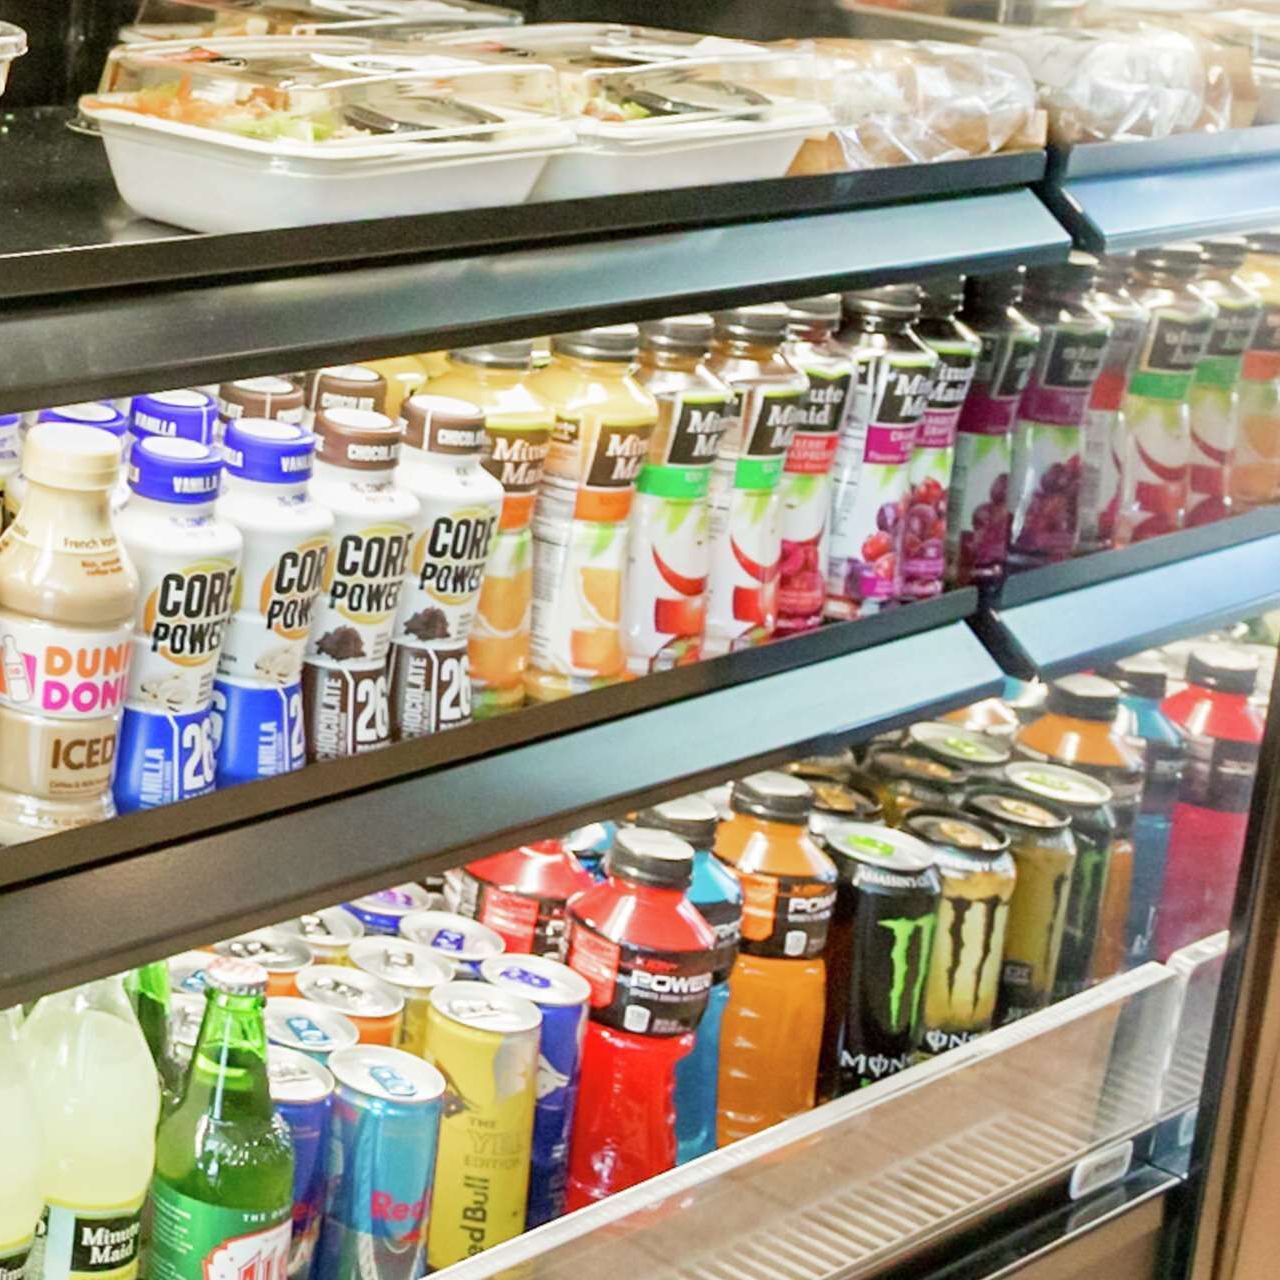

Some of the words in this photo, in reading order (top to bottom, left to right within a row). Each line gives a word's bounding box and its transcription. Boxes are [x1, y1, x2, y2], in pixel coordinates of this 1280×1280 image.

[64, 537, 99, 550] French
[356, 678, 391, 743] 26
[440, 655, 473, 722] 26
[463, 1175, 490, 1222] Bull
[89, 1242, 135, 1265] Maid
